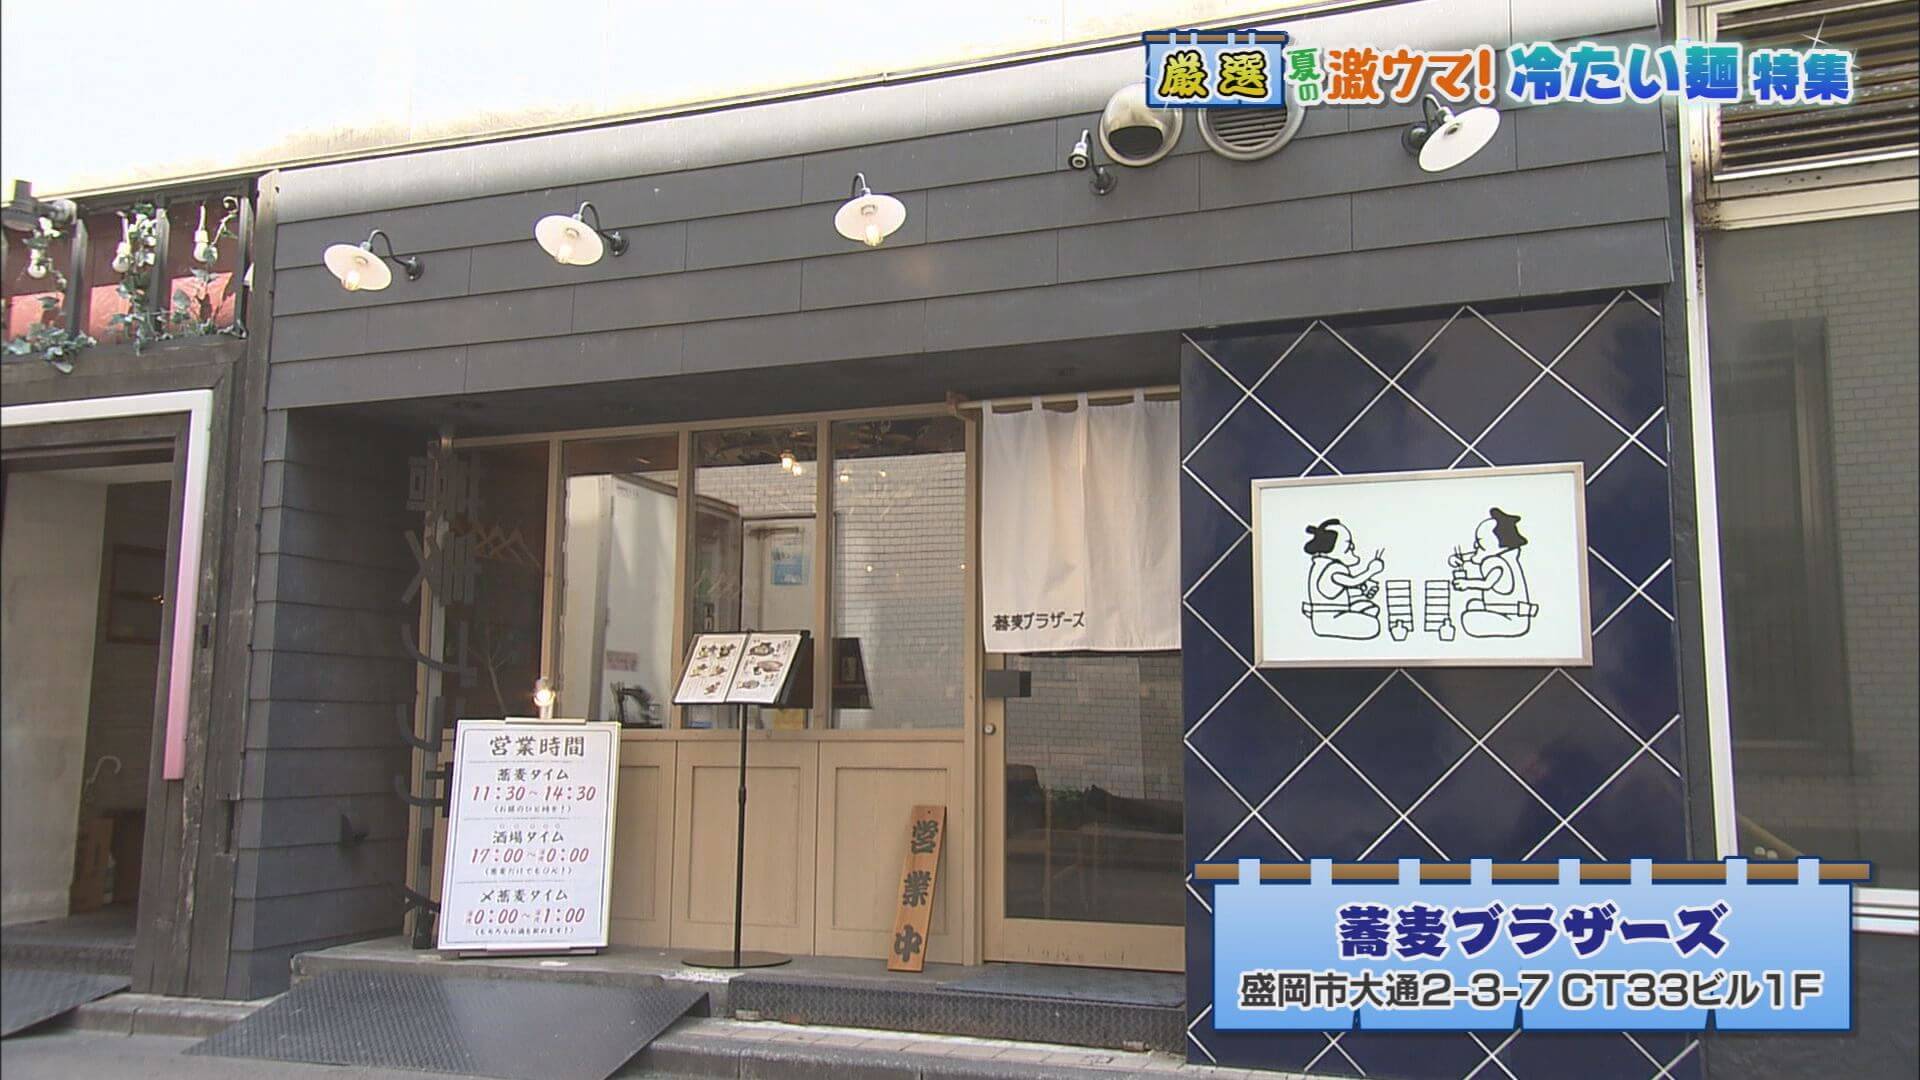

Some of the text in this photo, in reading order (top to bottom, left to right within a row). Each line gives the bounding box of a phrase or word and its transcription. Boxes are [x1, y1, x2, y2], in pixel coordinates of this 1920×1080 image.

[992, 612, 1085, 631] 蕎麦ブラザーズ
[489, 735, 585, 757] 営業時間
[497, 768, 569, 781] 蕎麦タイム
[492, 830, 564, 844] 酒場タイム
[894, 819, 938, 962] 営業中
